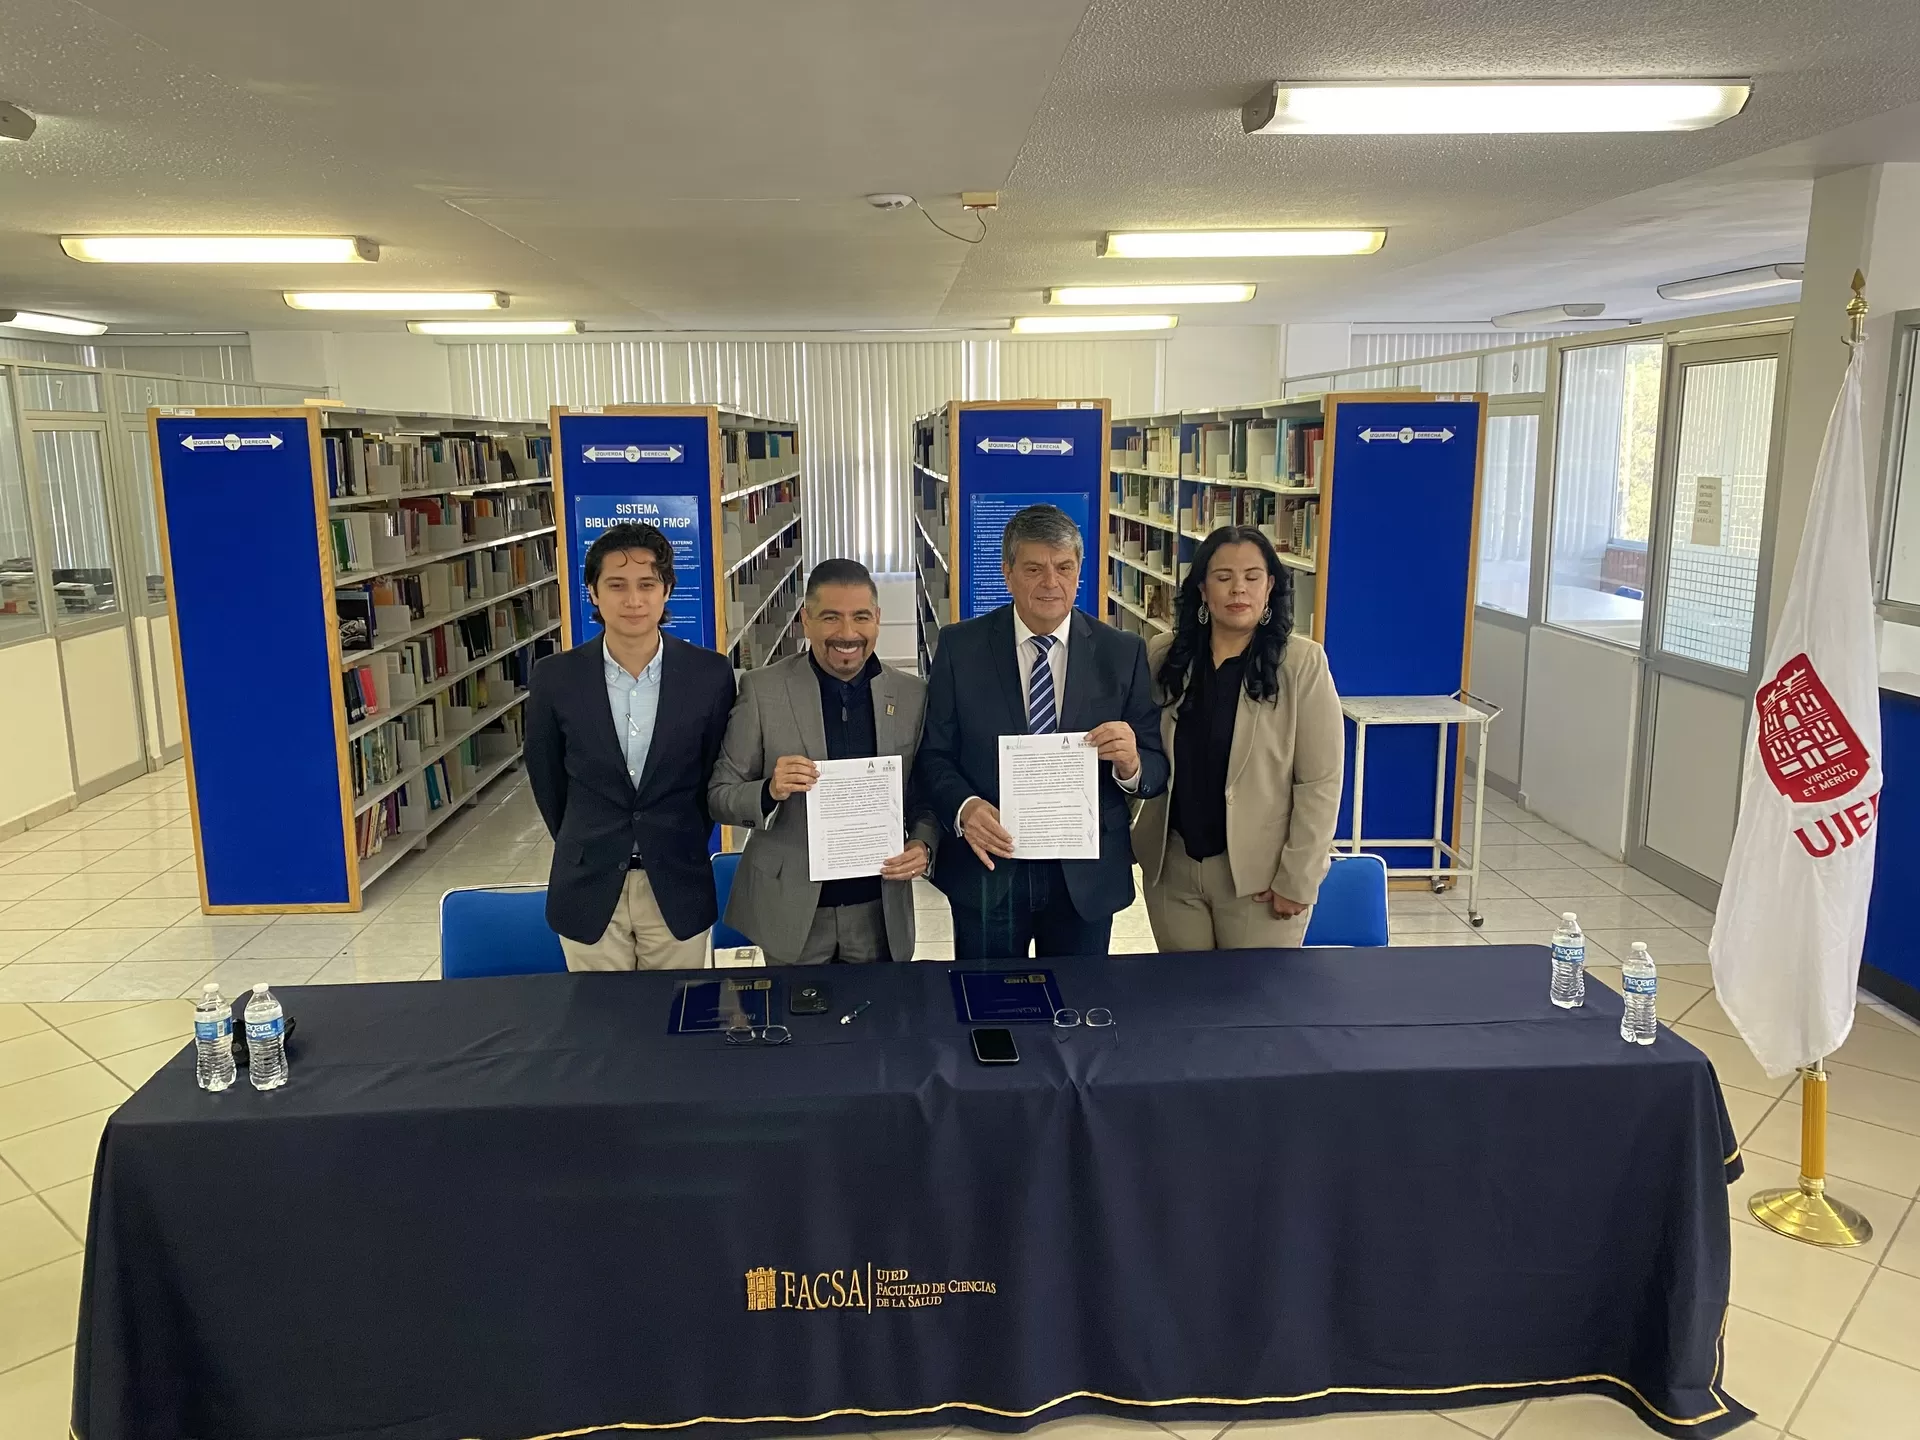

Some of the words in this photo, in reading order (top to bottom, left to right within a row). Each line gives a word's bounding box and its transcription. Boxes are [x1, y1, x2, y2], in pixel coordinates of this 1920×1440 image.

[56, 380, 64, 400] 7
[145, 386, 153, 404] 8
[616, 503, 660, 515] SISTEMA
[663, 517, 691, 528] FMGP
[1804, 762, 1847, 785] VIRTUTI
[1802, 785, 1817, 797] ET
[1819, 768, 1859, 791] MERITO
[876, 1269, 909, 1283] UJED
[781, 1269, 865, 1310] FACSA
[876, 1282, 930, 1296] FACULTAD
[932, 1282, 946, 1294] DE
[948, 1279, 997, 1294] CIENCIAS
[876, 1298, 890, 1307] DE
[892, 1298, 906, 1308] LA
[908, 1296, 942, 1307] SALUD
